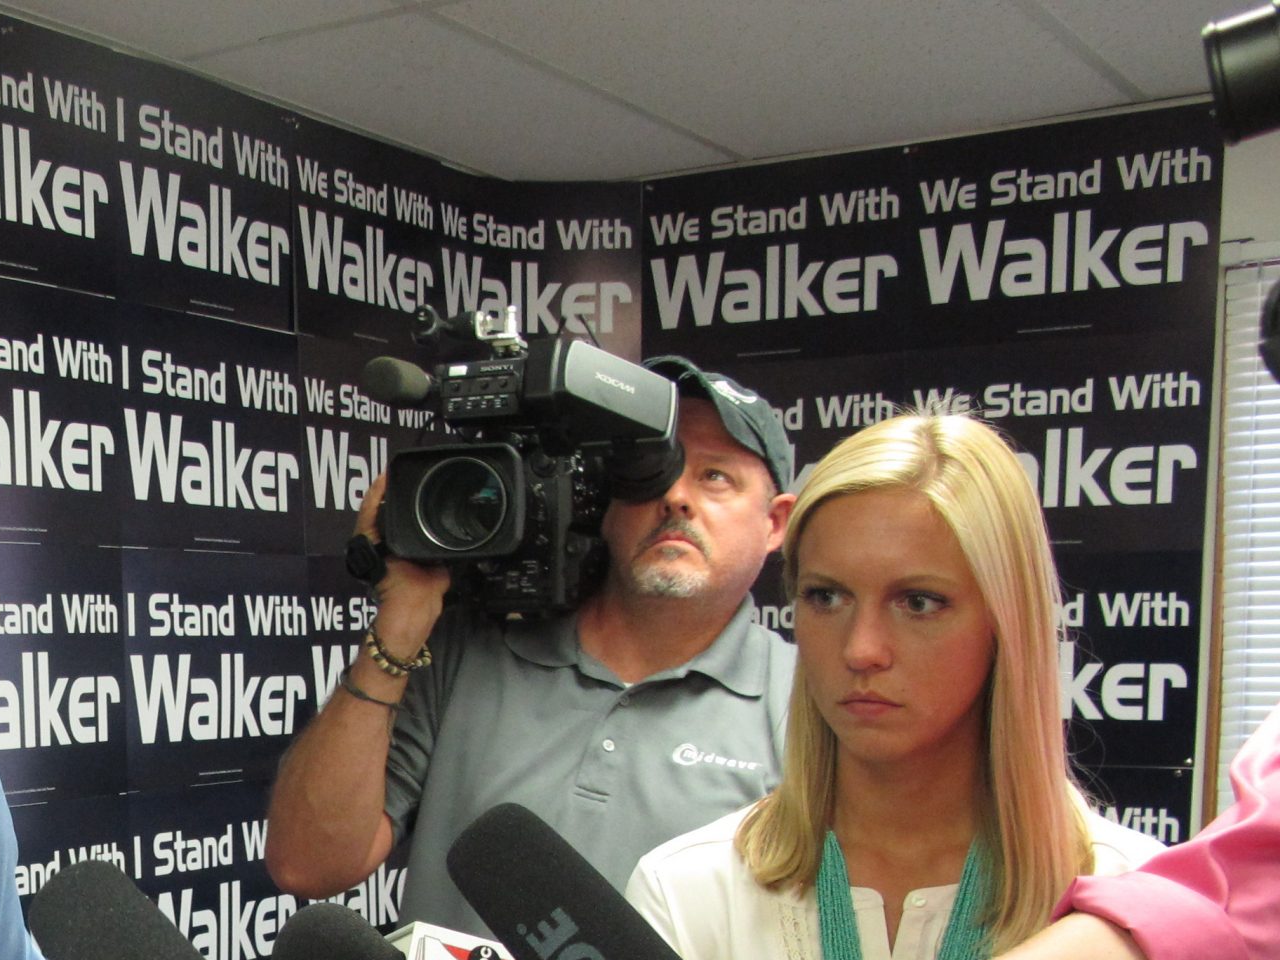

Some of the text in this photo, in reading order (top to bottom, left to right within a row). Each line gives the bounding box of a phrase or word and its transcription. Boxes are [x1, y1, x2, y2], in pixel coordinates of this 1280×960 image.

[43, 77, 106, 132] With
[117, 98, 288, 189] I Stand With
[334, 169, 387, 216] Stand
[394, 187, 433, 229] With
[991, 160, 1101, 205] Stand
[1117, 147, 1211, 190] With
[120, 159, 289, 285] Walker
[473, 213, 544, 250] Stand
[557, 219, 631, 250] With
[711, 198, 806, 239] Stand
[820, 187, 899, 226] With
[299, 203, 433, 313] Walker
[651, 244, 898, 329] Walker
[920, 210, 1208, 304] Walker
[442, 248, 634, 336] Walker
[53, 337, 112, 384] With
[122, 346, 297, 414] I Stand With
[984, 378, 1093, 418] Stand
[1109, 372, 1200, 410] With
[124, 408, 299, 512] Walker
[61, 594, 117, 633] With
[128, 593, 306, 636] I Stand With
[1099, 592, 1189, 626] With
[130, 654, 306, 744] Walker
[1060, 641, 1187, 720] ker
[154, 824, 232, 876] Stand
